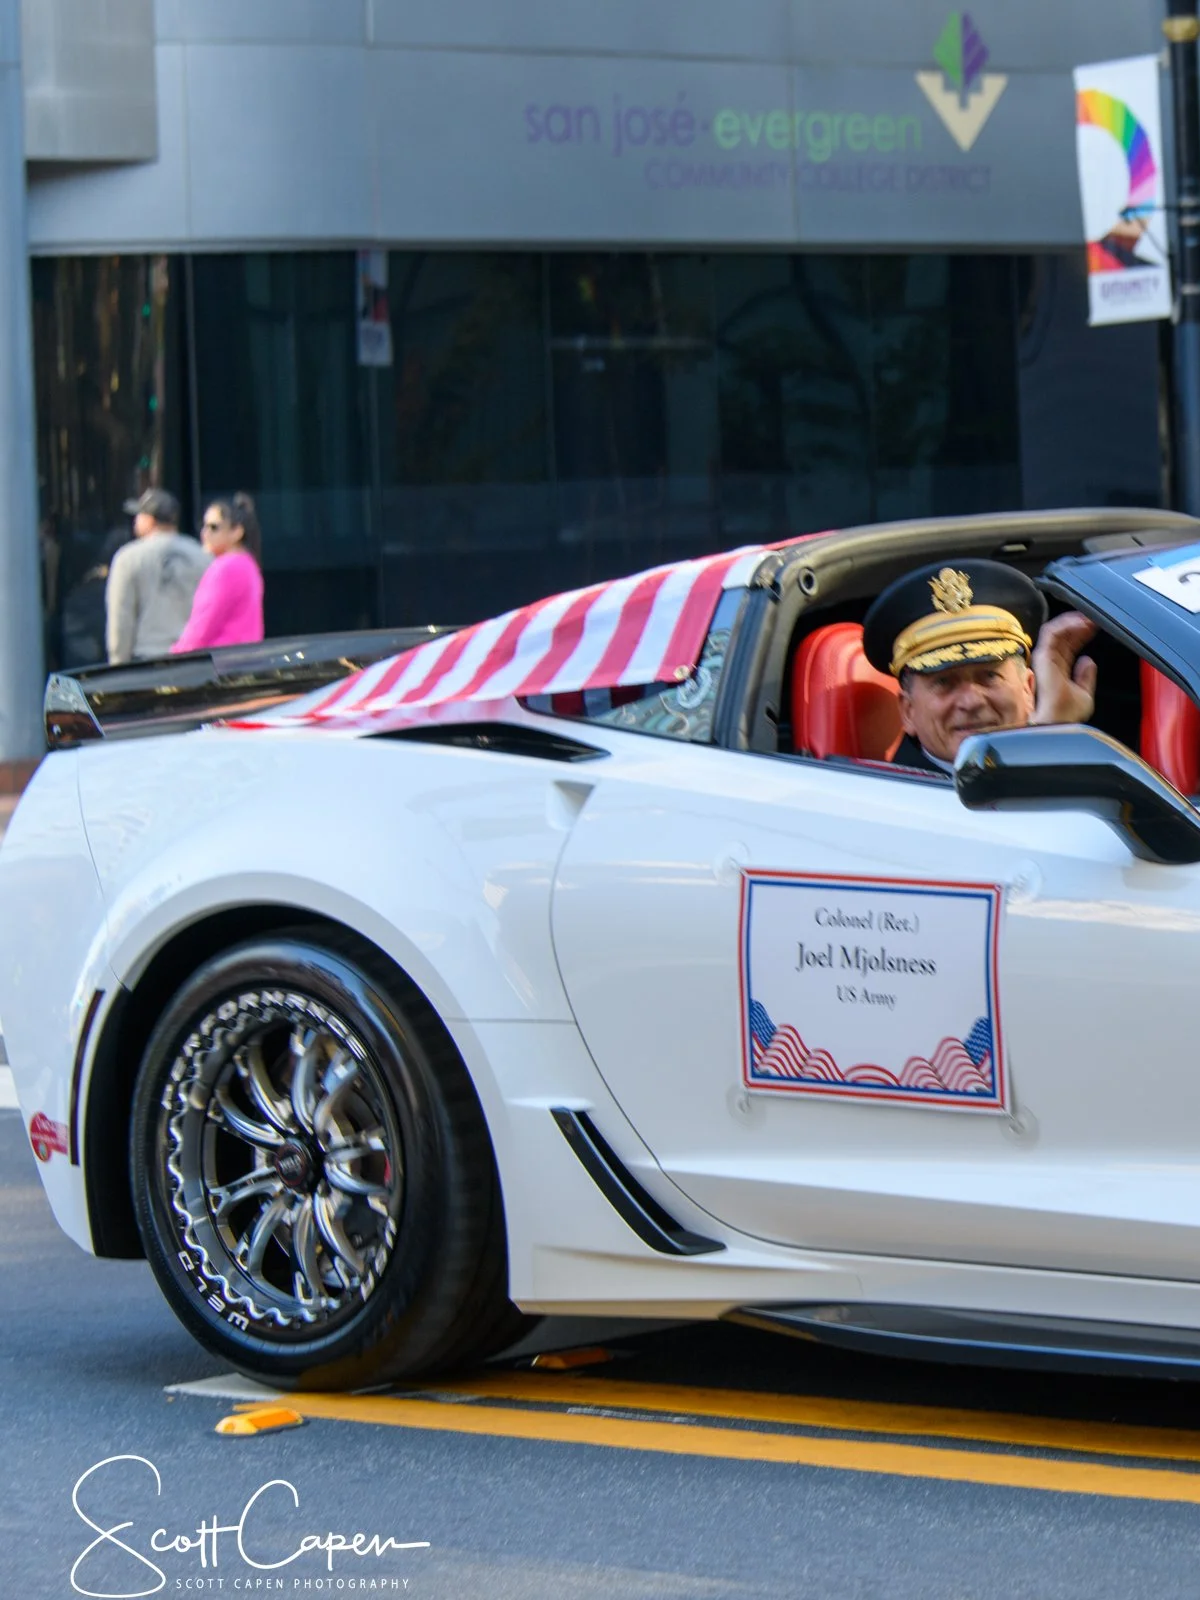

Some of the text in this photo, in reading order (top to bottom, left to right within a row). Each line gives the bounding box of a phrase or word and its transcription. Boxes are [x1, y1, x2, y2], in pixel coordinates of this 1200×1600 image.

[523, 102, 601, 145] san
[814, 906, 919, 934] Colonel (Ret.)
[795, 942, 937, 978] Joel Mjolsness
[836, 985, 897, 1011] US Army
[178, 1250, 250, 1332] WELD
